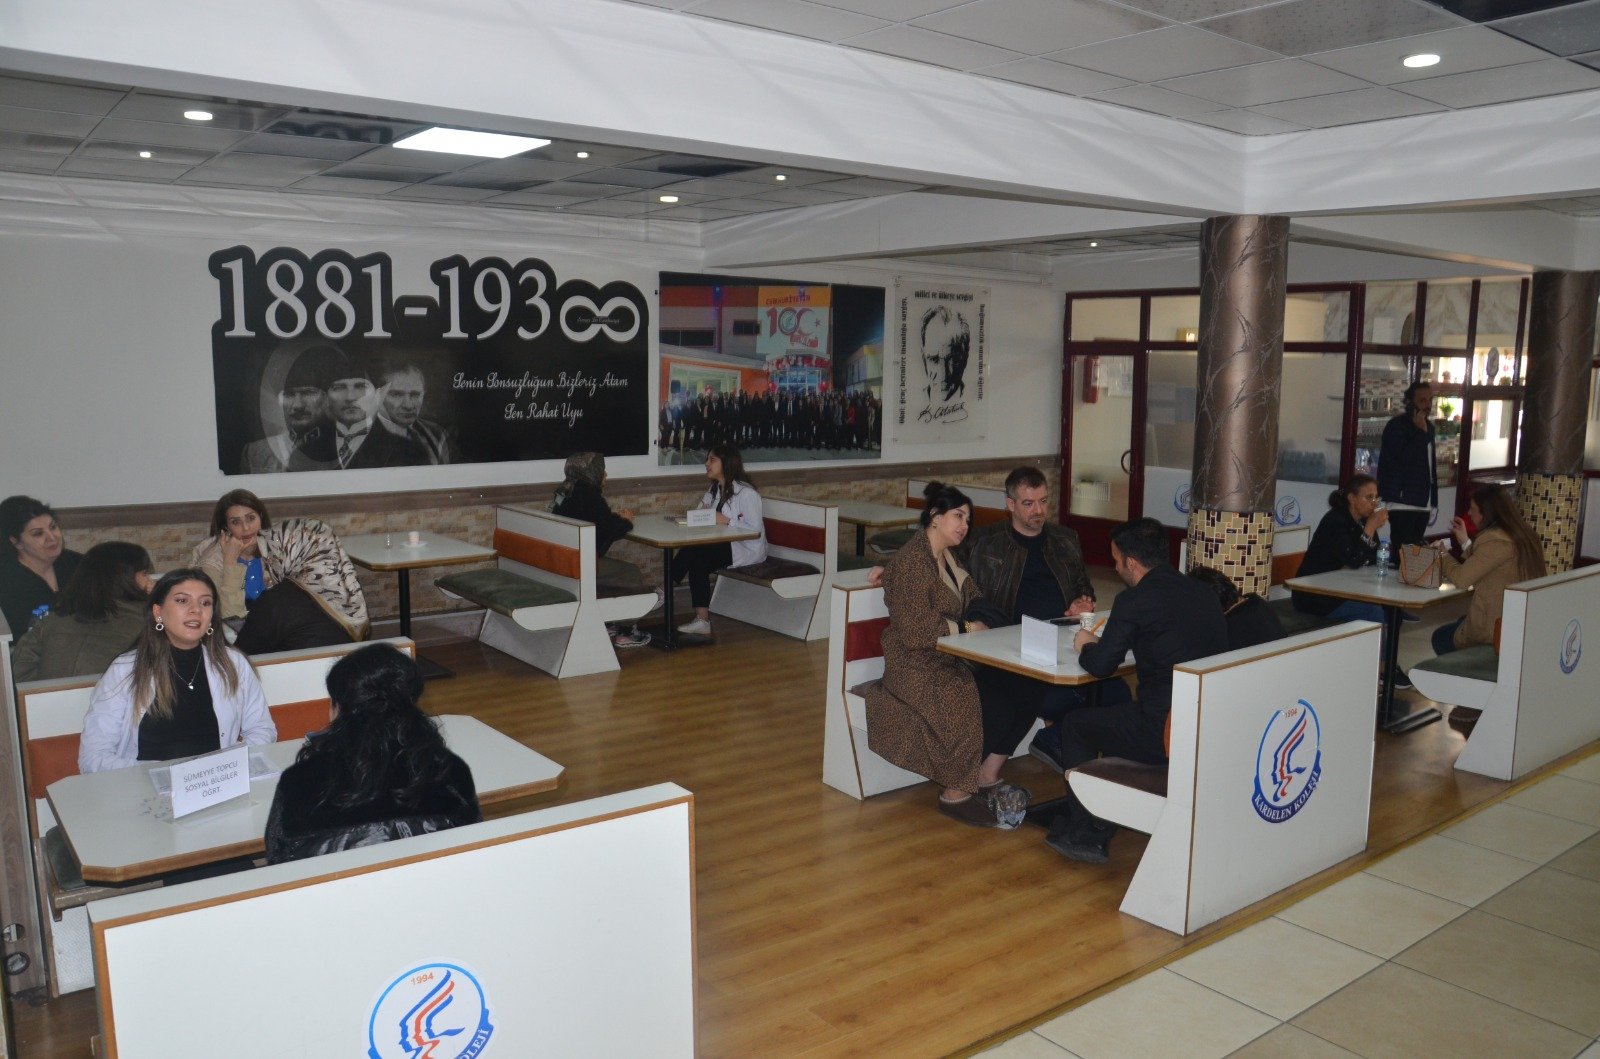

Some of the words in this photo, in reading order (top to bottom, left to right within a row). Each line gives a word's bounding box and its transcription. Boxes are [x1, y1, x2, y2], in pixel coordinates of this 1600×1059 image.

[452, 372, 484, 389] Senin
[486, 370, 554, 398] Sonsuzluğun
[556, 370, 597, 397] Bizleriz
[599, 371, 628, 388] Atam
[504, 403, 524, 420] Sen
[526, 401, 559, 419] Rahat
[561, 402, 584, 427] Uyu
[183, 767, 214, 783] SÜMEYYE
[184, 781, 209, 793] SOSYAL
[211, 771, 238, 785] BİLGİLER
[1254, 794, 1293, 821] KARDELEN
[411, 973, 434, 986] 1994
